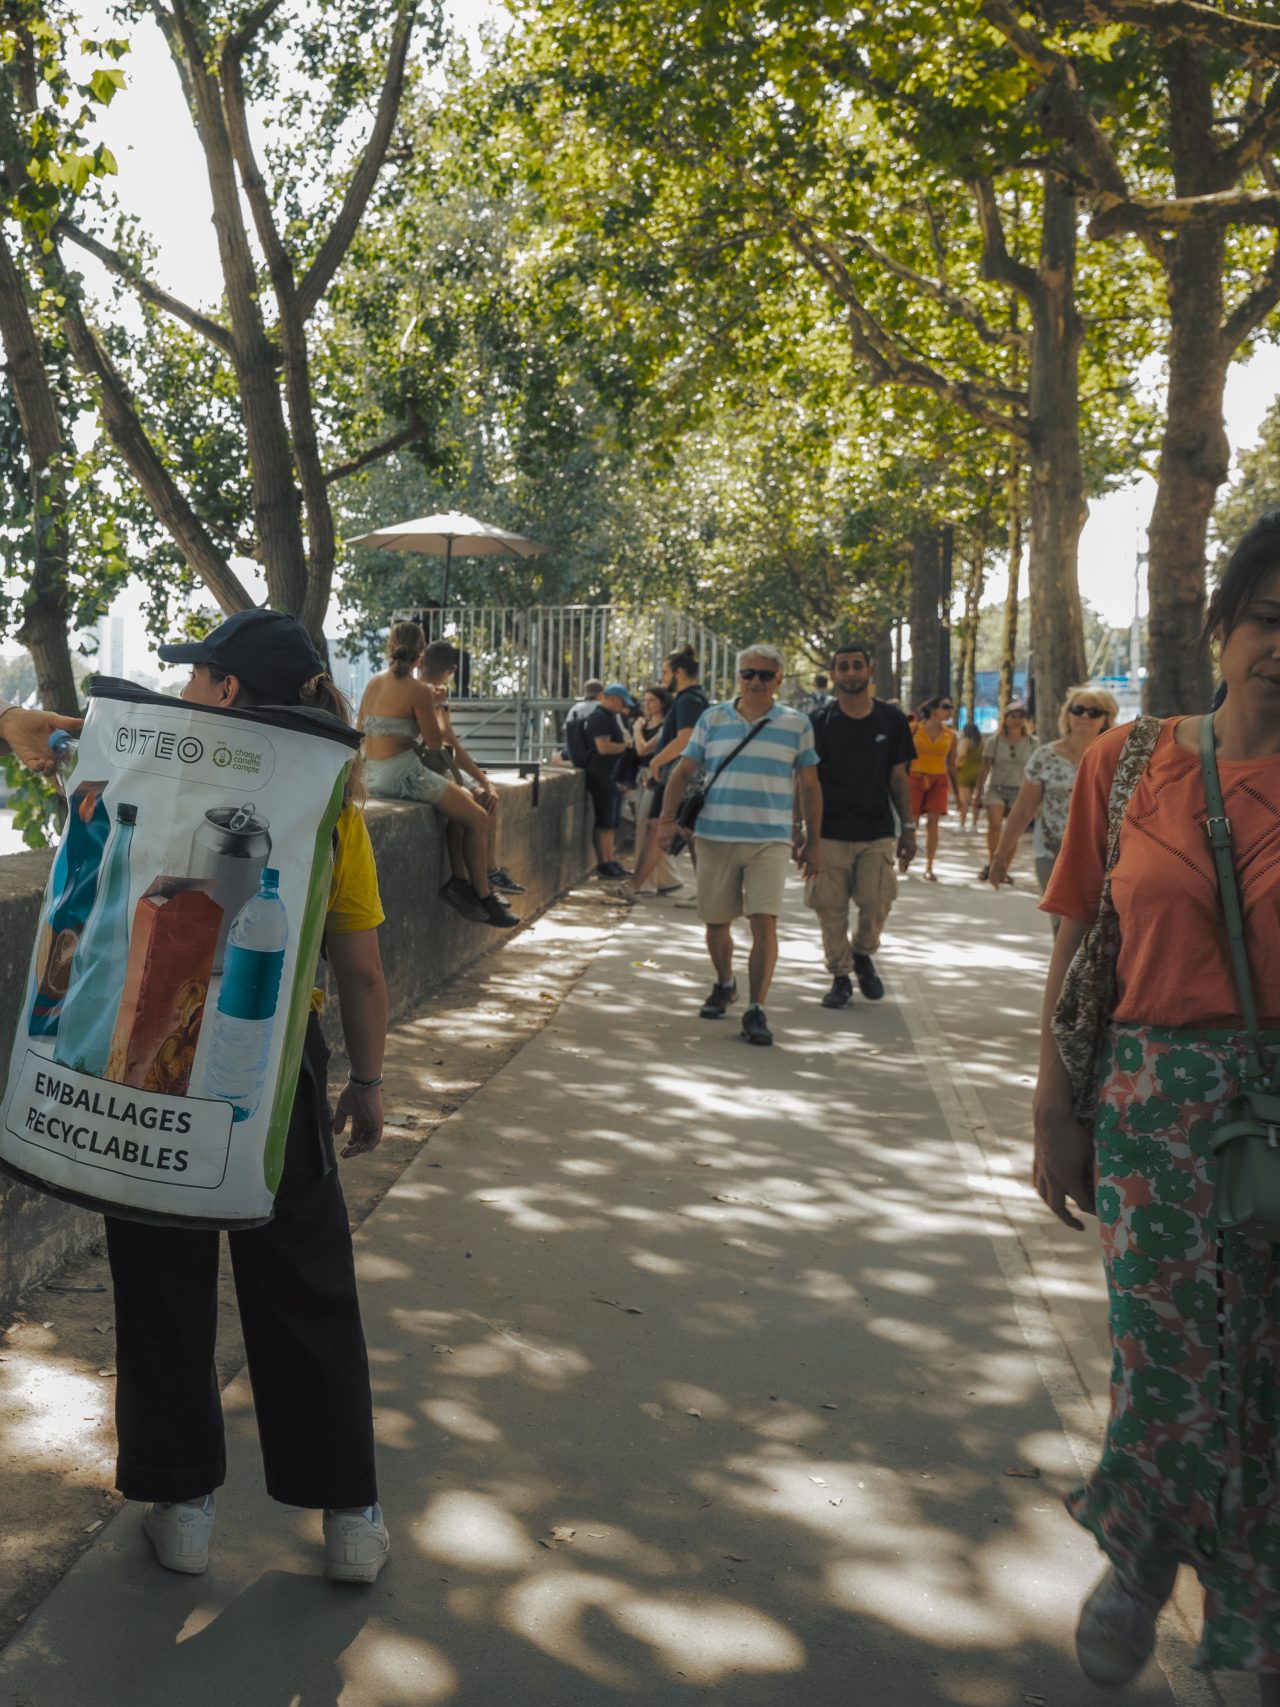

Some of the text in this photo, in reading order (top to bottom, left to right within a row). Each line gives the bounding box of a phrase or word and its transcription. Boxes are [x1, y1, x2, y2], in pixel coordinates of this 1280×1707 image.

[115, 726, 204, 764] CITEO
[34, 1071, 192, 1134] EMBALLAGES
[25, 1106, 190, 1172] RECYCLABLES
